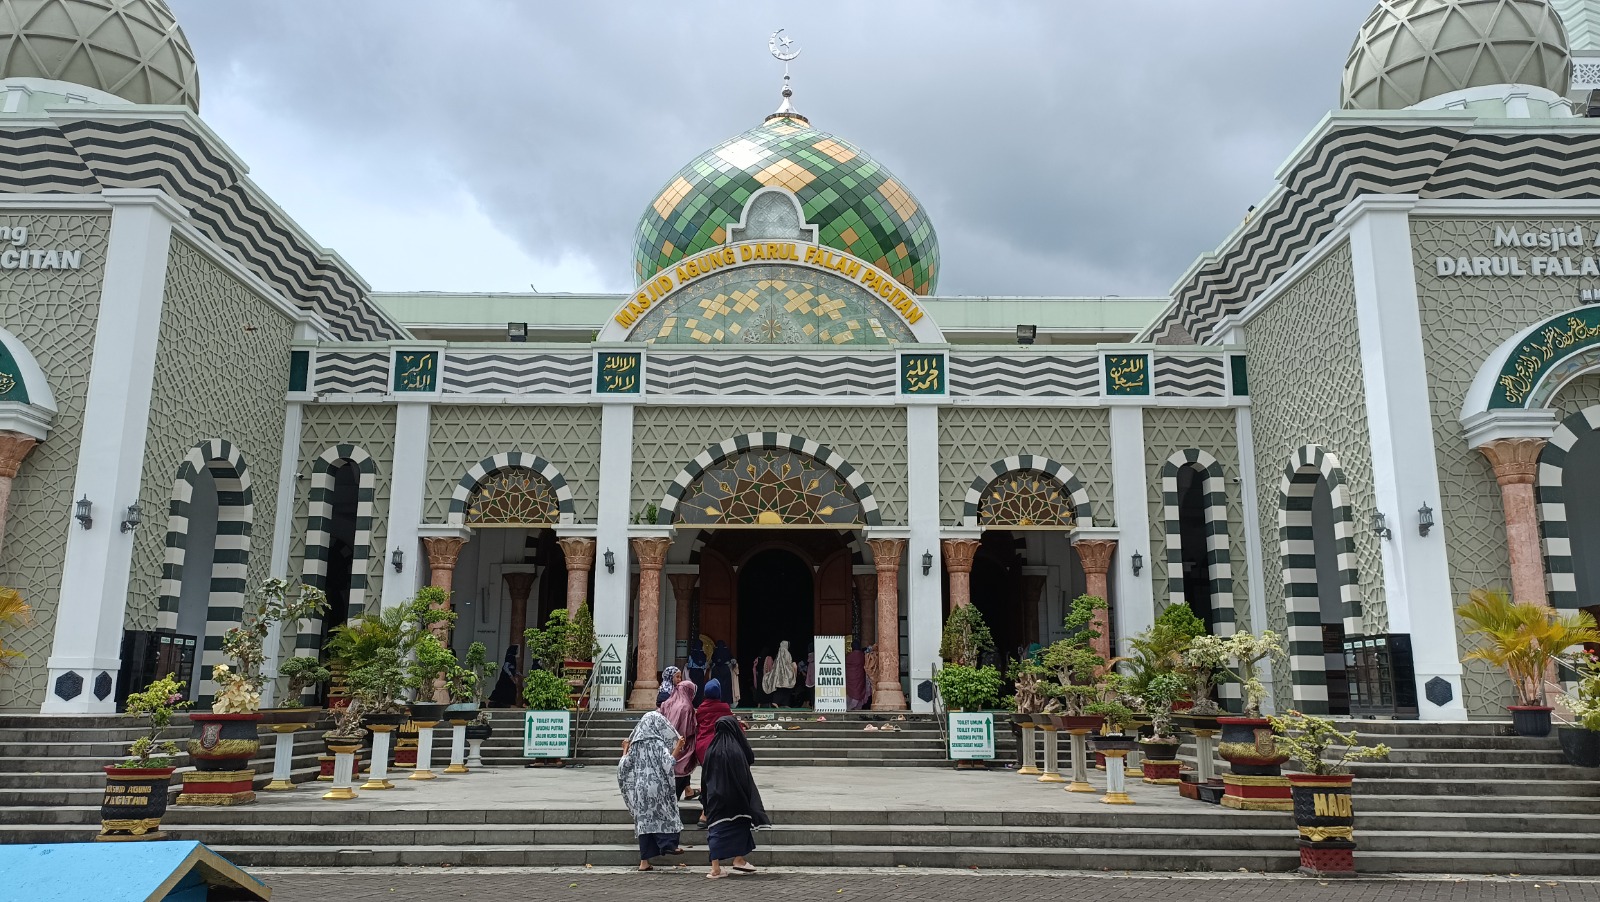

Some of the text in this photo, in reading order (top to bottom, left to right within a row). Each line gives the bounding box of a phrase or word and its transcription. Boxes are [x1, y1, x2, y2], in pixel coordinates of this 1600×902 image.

[1493, 225, 1584, 252] Masjid
[1436, 256, 1527, 276] DARUL
[615, 243, 924, 329] MASJID AGUNG DARUL FALAH PACITAN
[598, 666, 621, 675] AWAS
[819, 667, 842, 676] AWAS
[817, 677, 844, 686] LANTAI
[820, 688, 841, 696] LICIN
